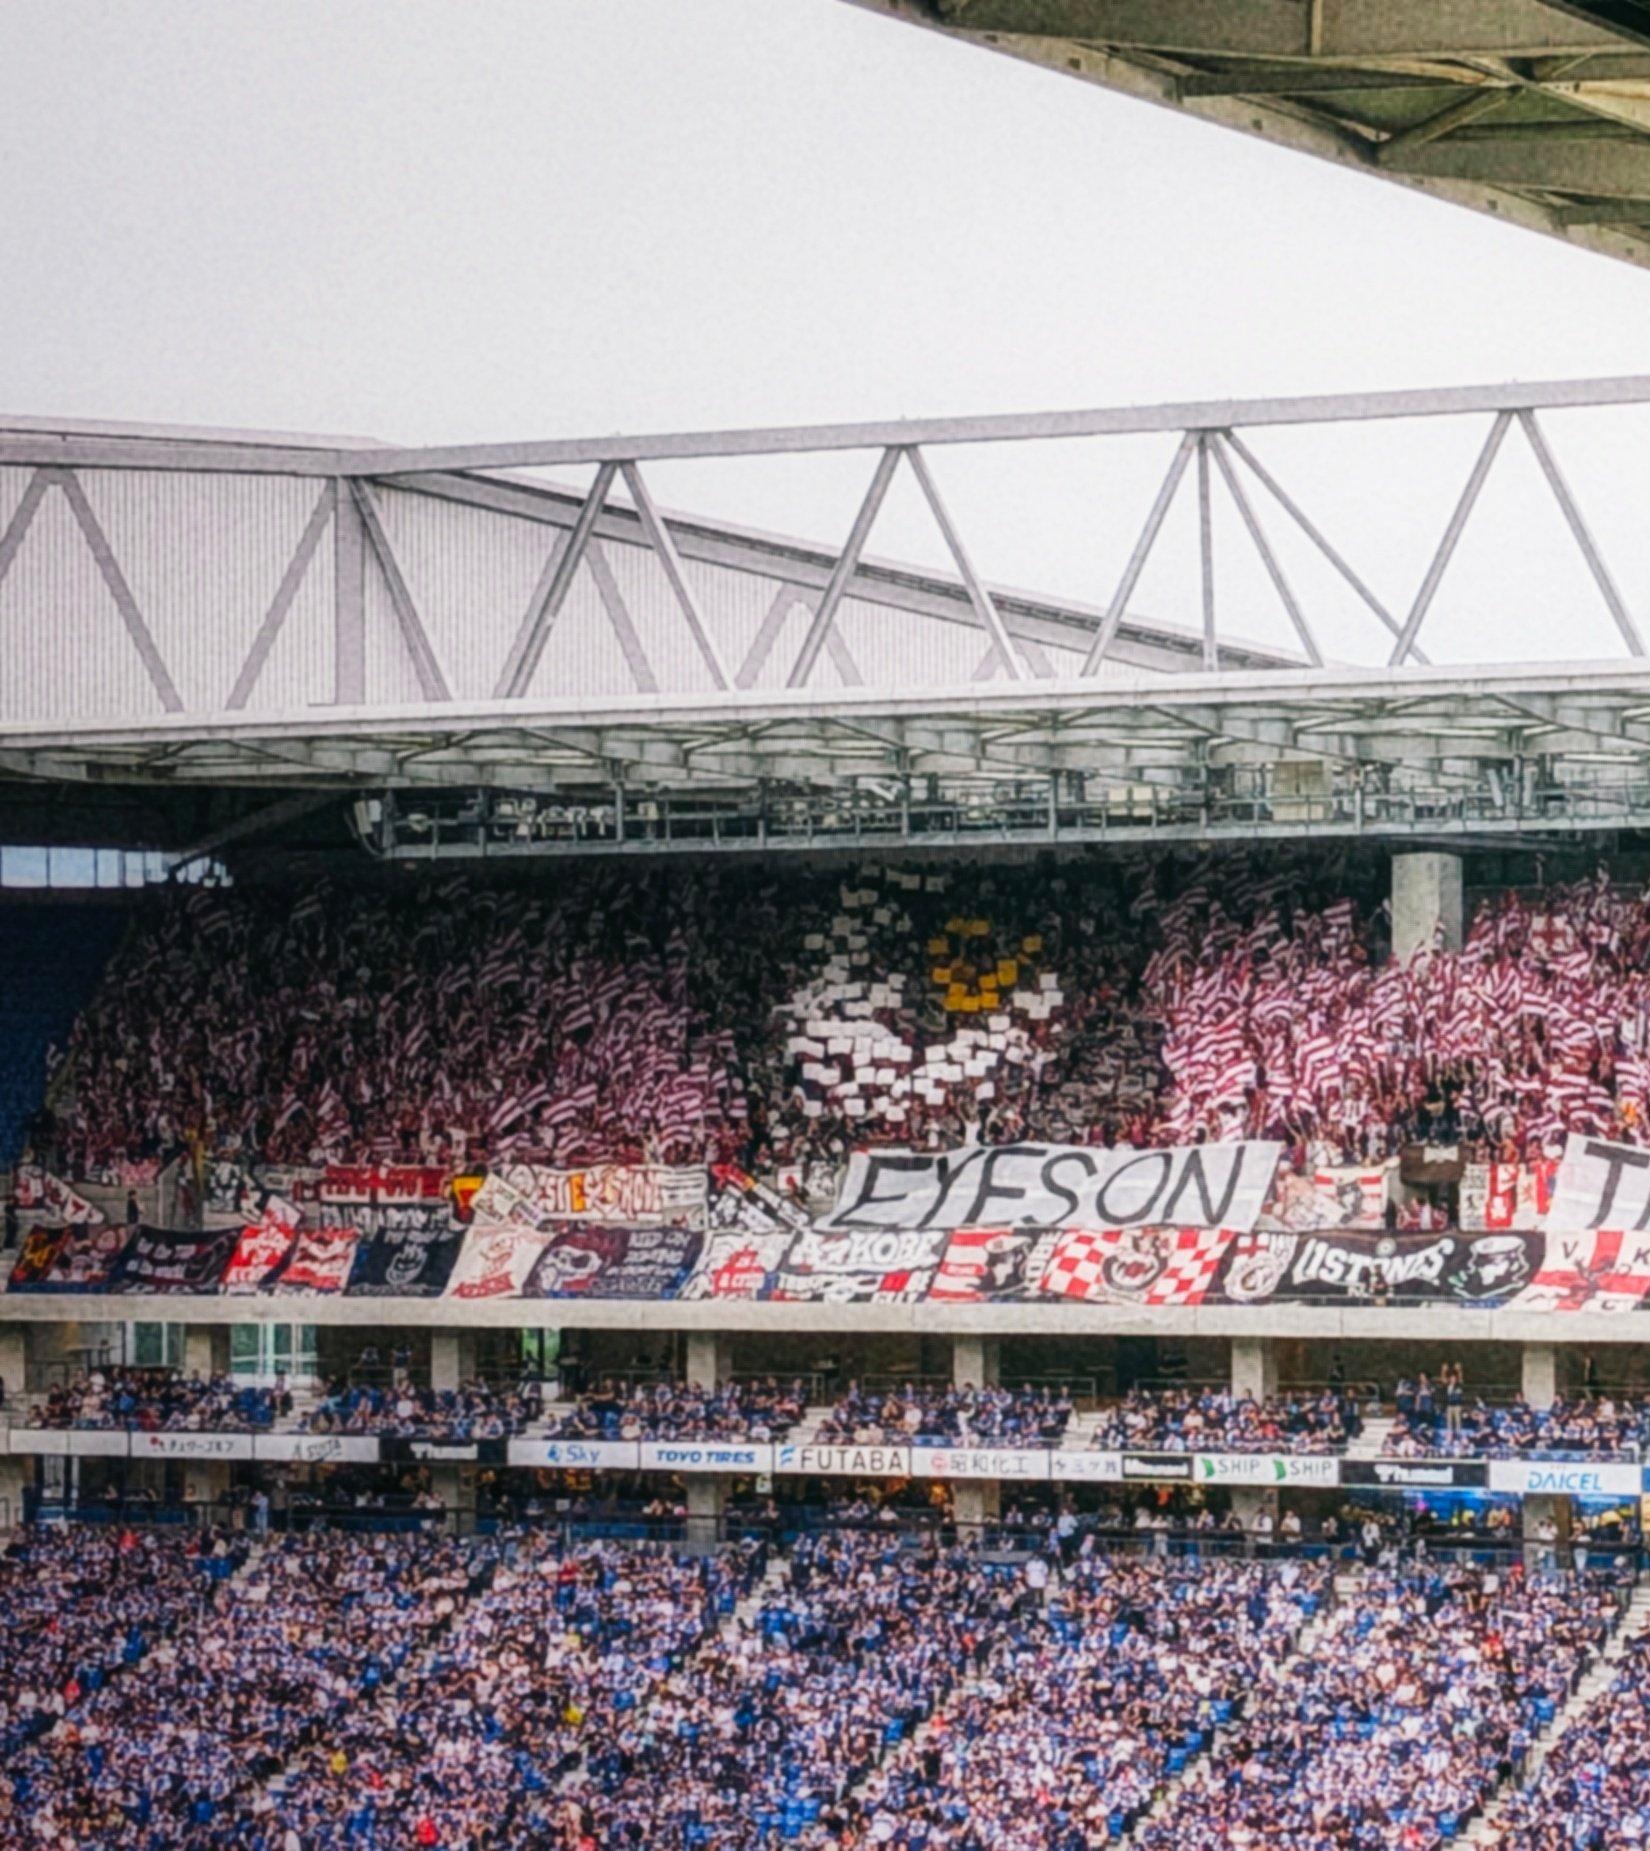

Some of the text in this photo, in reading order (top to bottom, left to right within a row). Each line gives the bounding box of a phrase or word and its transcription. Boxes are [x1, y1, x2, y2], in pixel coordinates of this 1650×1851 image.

[656, 1450, 755, 1464] TOYO TIRES
[800, 1449, 902, 1471] FUTABA
[1219, 1459, 1261, 1475] SHIP
[1291, 1460, 1332, 1477] SHIP
[1528, 1471, 1603, 1491] DAICEL
